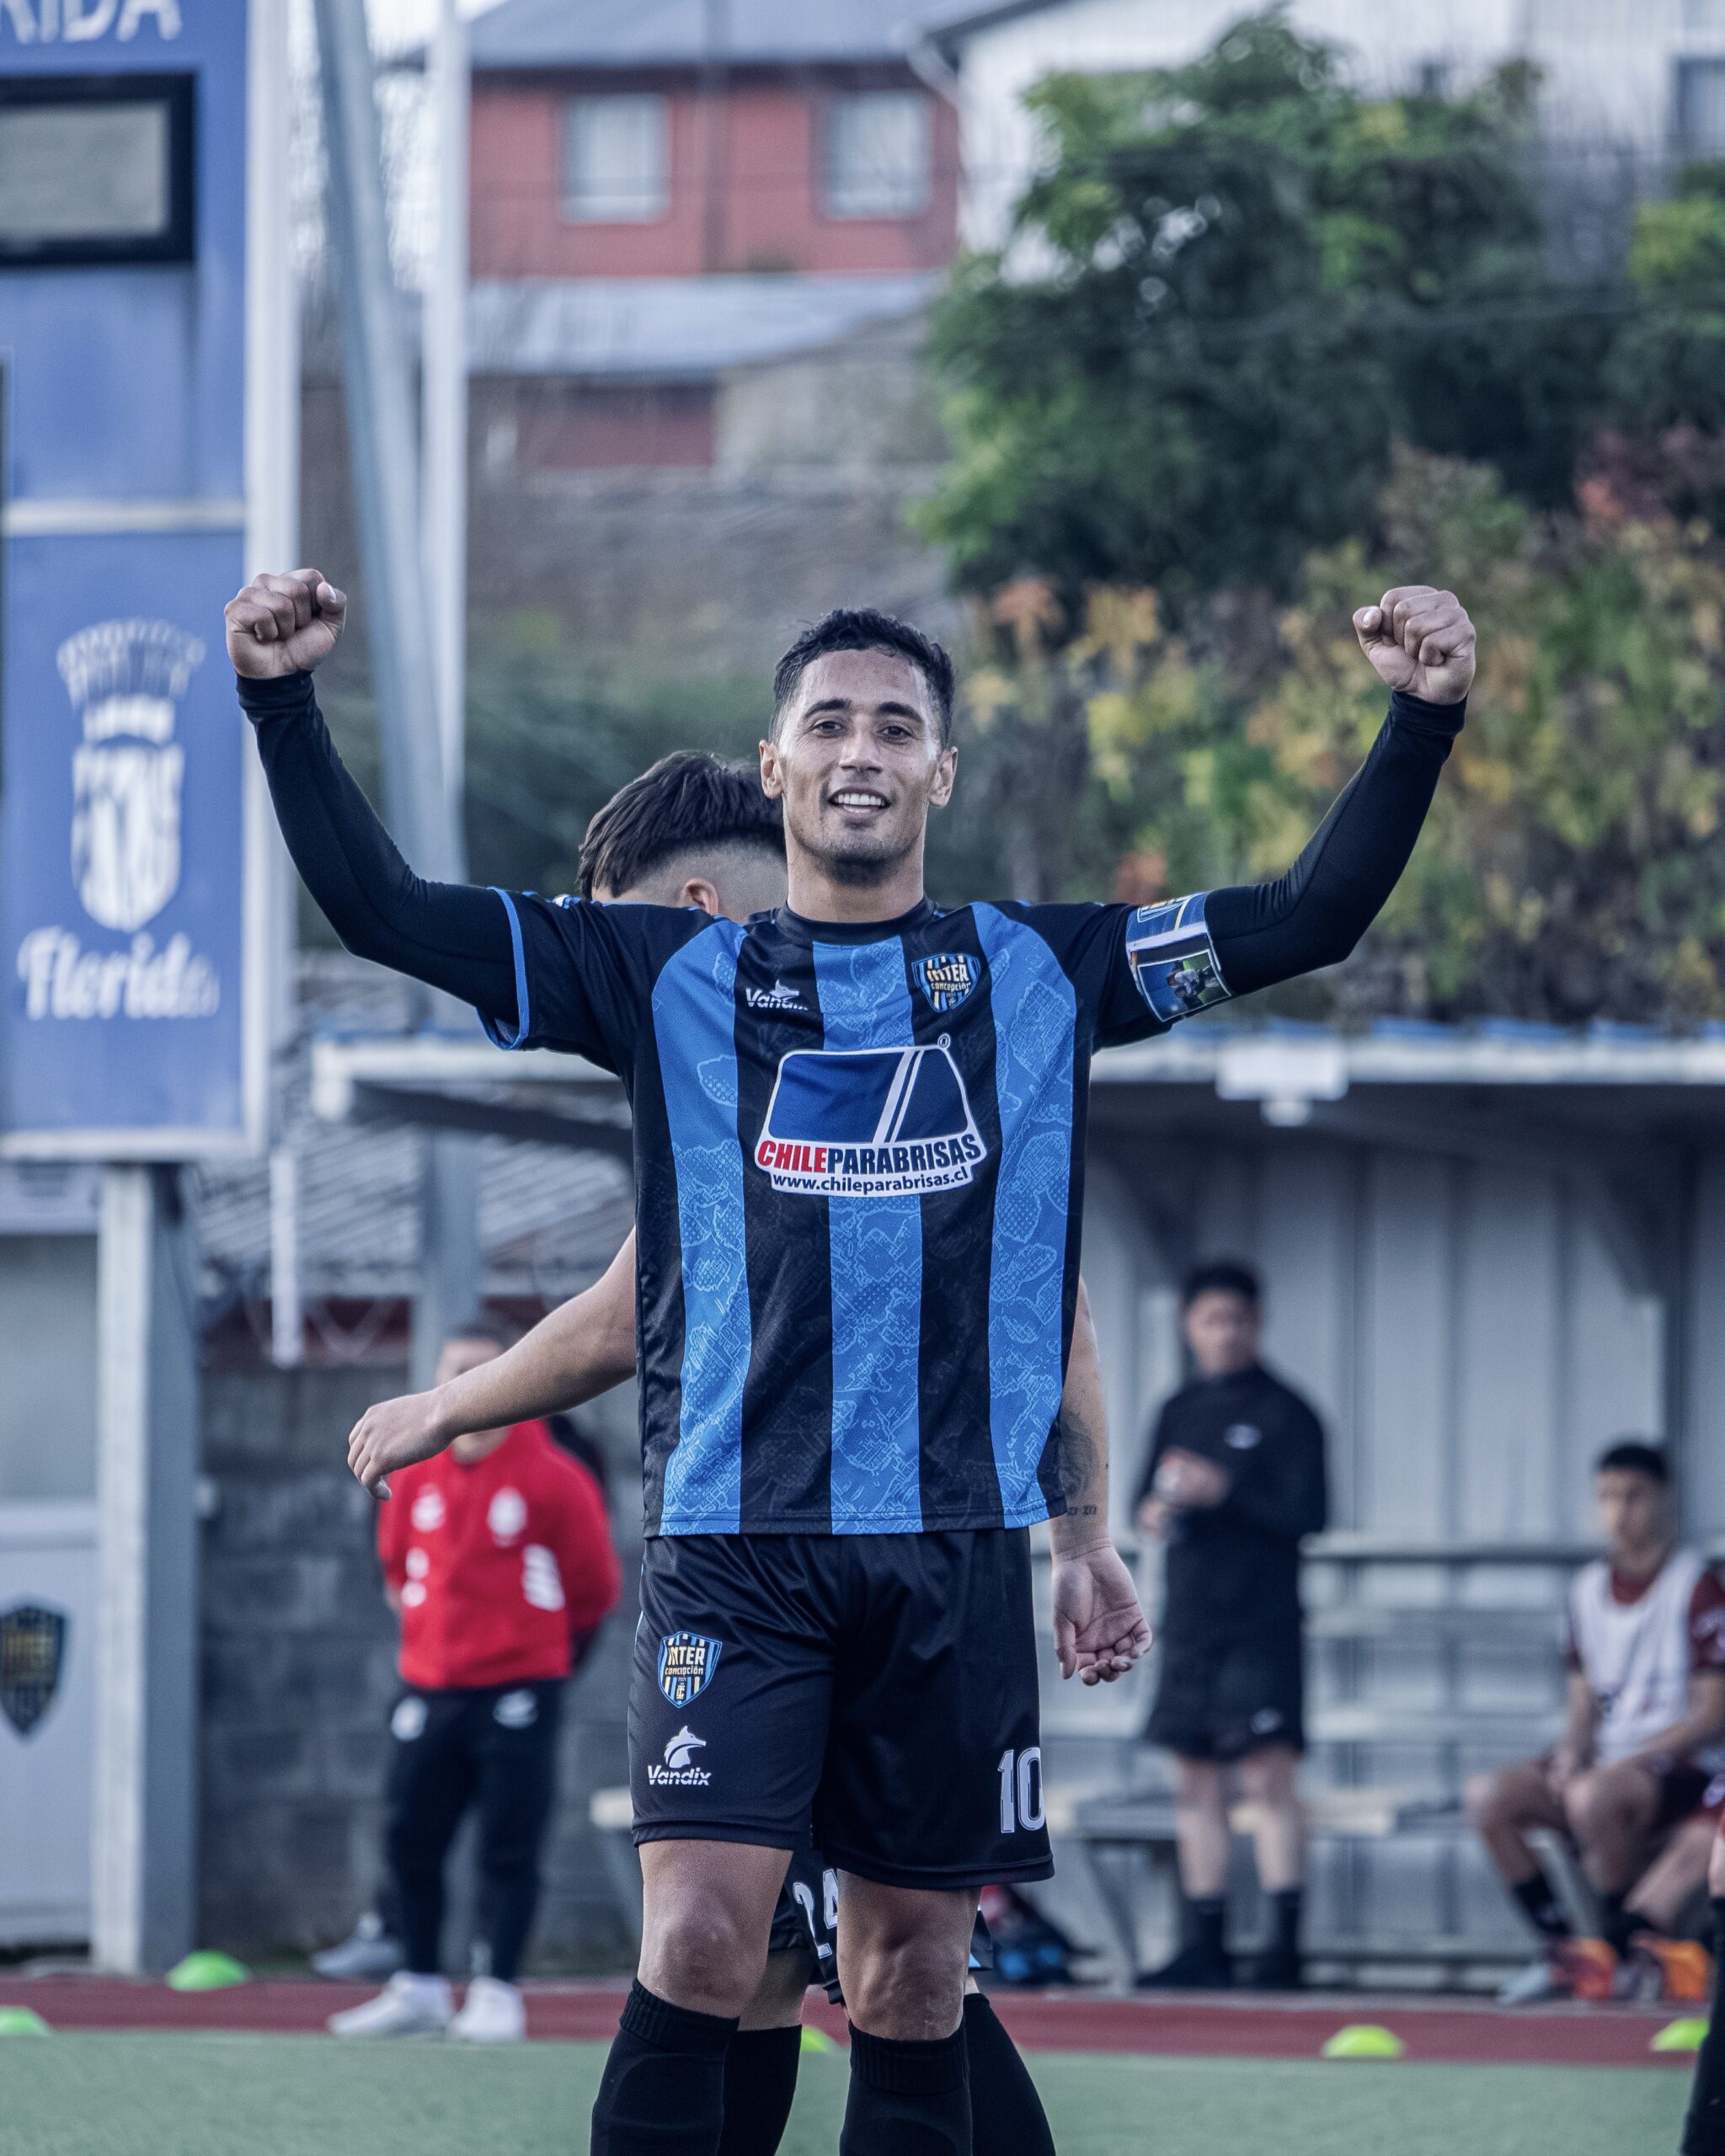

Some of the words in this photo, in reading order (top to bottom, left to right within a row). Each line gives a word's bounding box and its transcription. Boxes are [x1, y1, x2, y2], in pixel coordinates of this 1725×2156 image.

[927, 963, 969, 982] INTER
[758, 1134, 981, 1175] CHILEPARABRISAS
[773, 1166, 968, 1194] www.chileparabrisas.cl
[648, 1765, 711, 1785] Vandix
[997, 1747, 1045, 1833] 10
